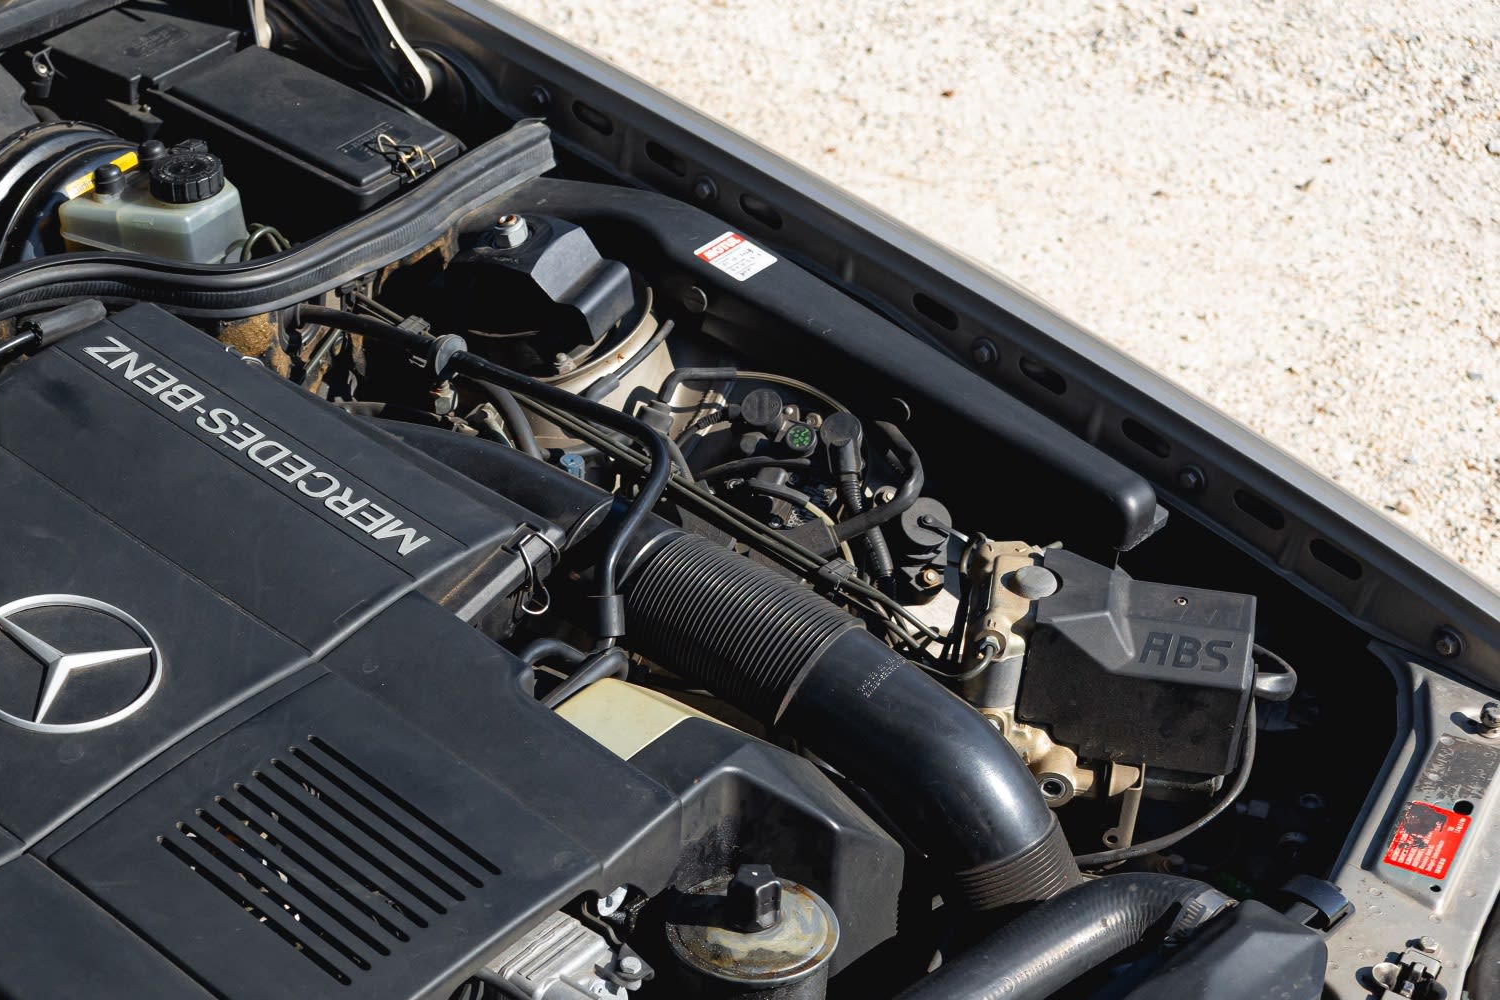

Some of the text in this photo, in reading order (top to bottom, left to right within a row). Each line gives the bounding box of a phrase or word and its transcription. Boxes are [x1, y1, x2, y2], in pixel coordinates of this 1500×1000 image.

[703, 236, 742, 260] MOTUL
[82, 335, 432, 557] MERCEDES-BENZ
[1139, 631, 1234, 673] ABS
